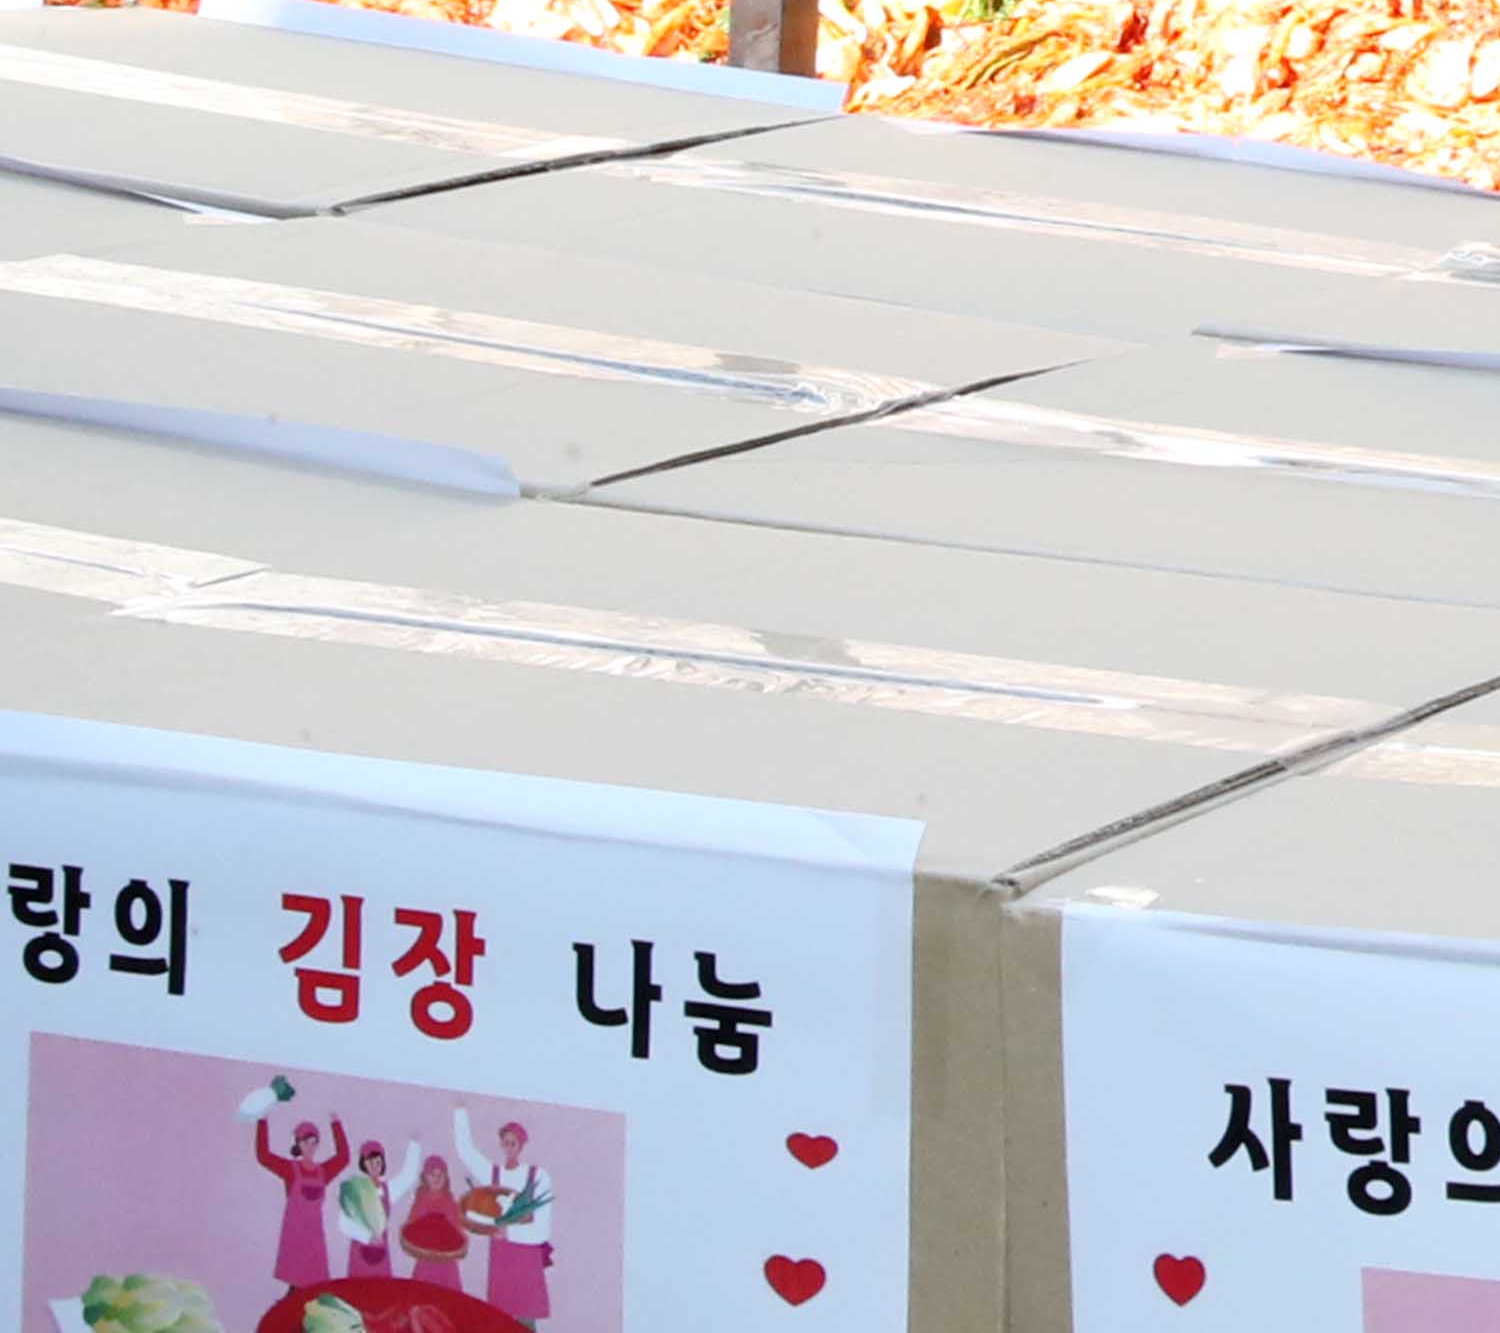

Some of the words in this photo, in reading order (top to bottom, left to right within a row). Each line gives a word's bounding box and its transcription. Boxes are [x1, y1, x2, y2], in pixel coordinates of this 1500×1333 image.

[7, 863, 190, 996] 랑의
[280, 893, 486, 1040] 김장
[572, 939, 774, 1076] 나눔
